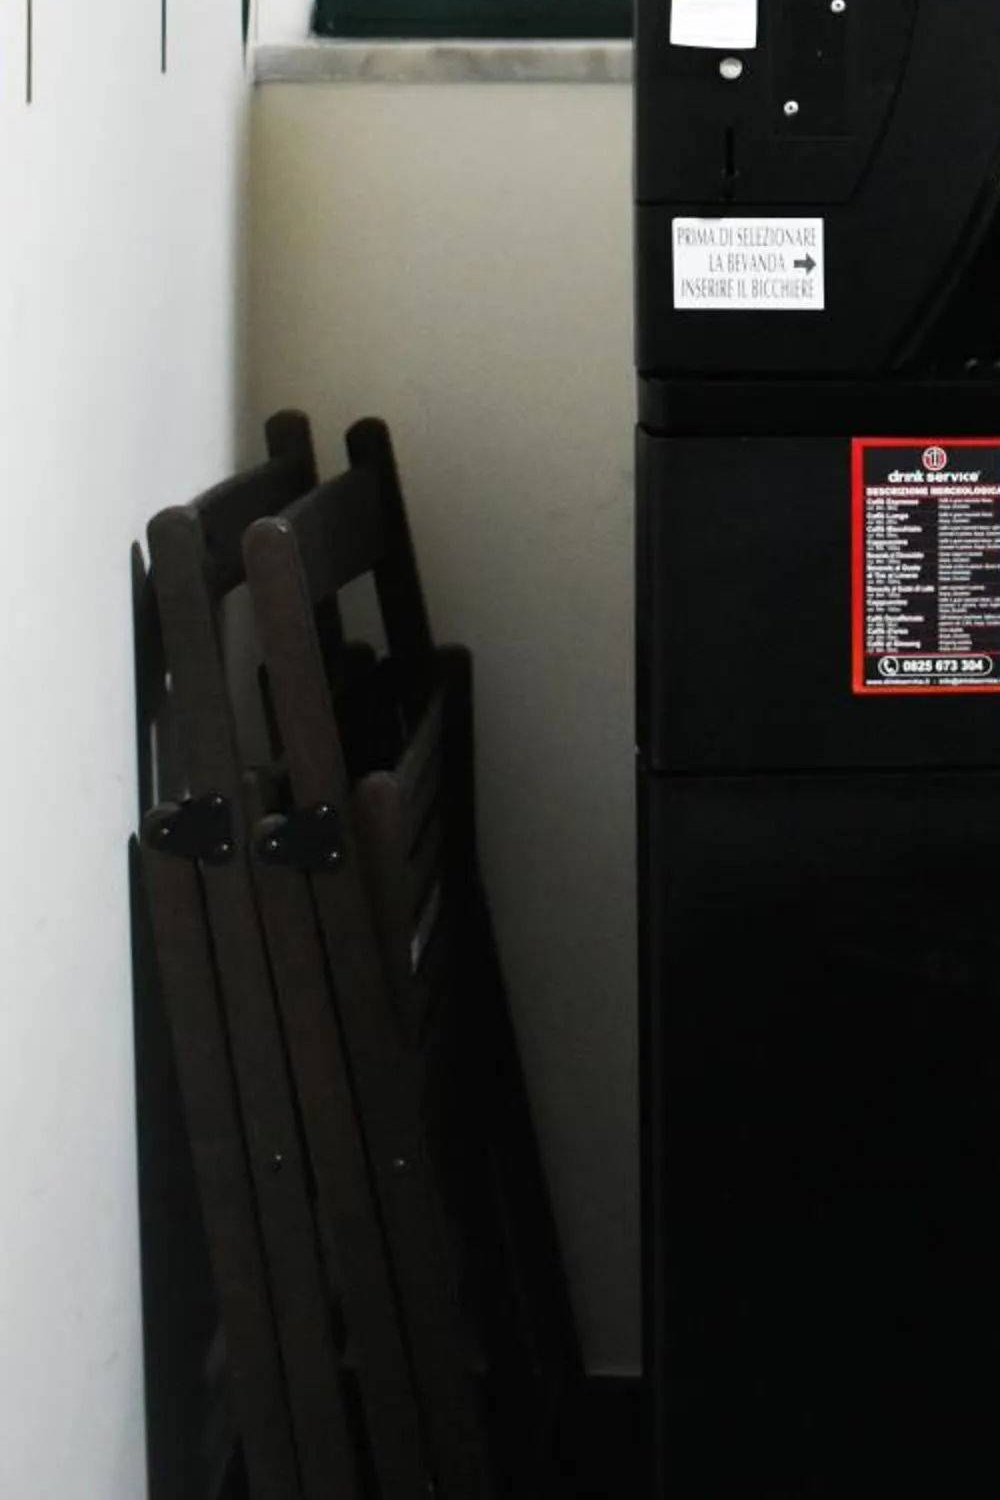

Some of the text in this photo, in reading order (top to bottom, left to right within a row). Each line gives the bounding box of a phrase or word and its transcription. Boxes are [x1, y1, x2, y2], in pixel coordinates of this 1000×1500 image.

[677, 226, 817, 247] PRIMA DI SELEZIONARE
[708, 252, 787, 273] LA BEVANDA
[681, 278, 815, 299] INSERIRE IL BICCHIERE
[887, 469, 979, 483] drink service
[903, 659, 983, 672] 0825 673 304
